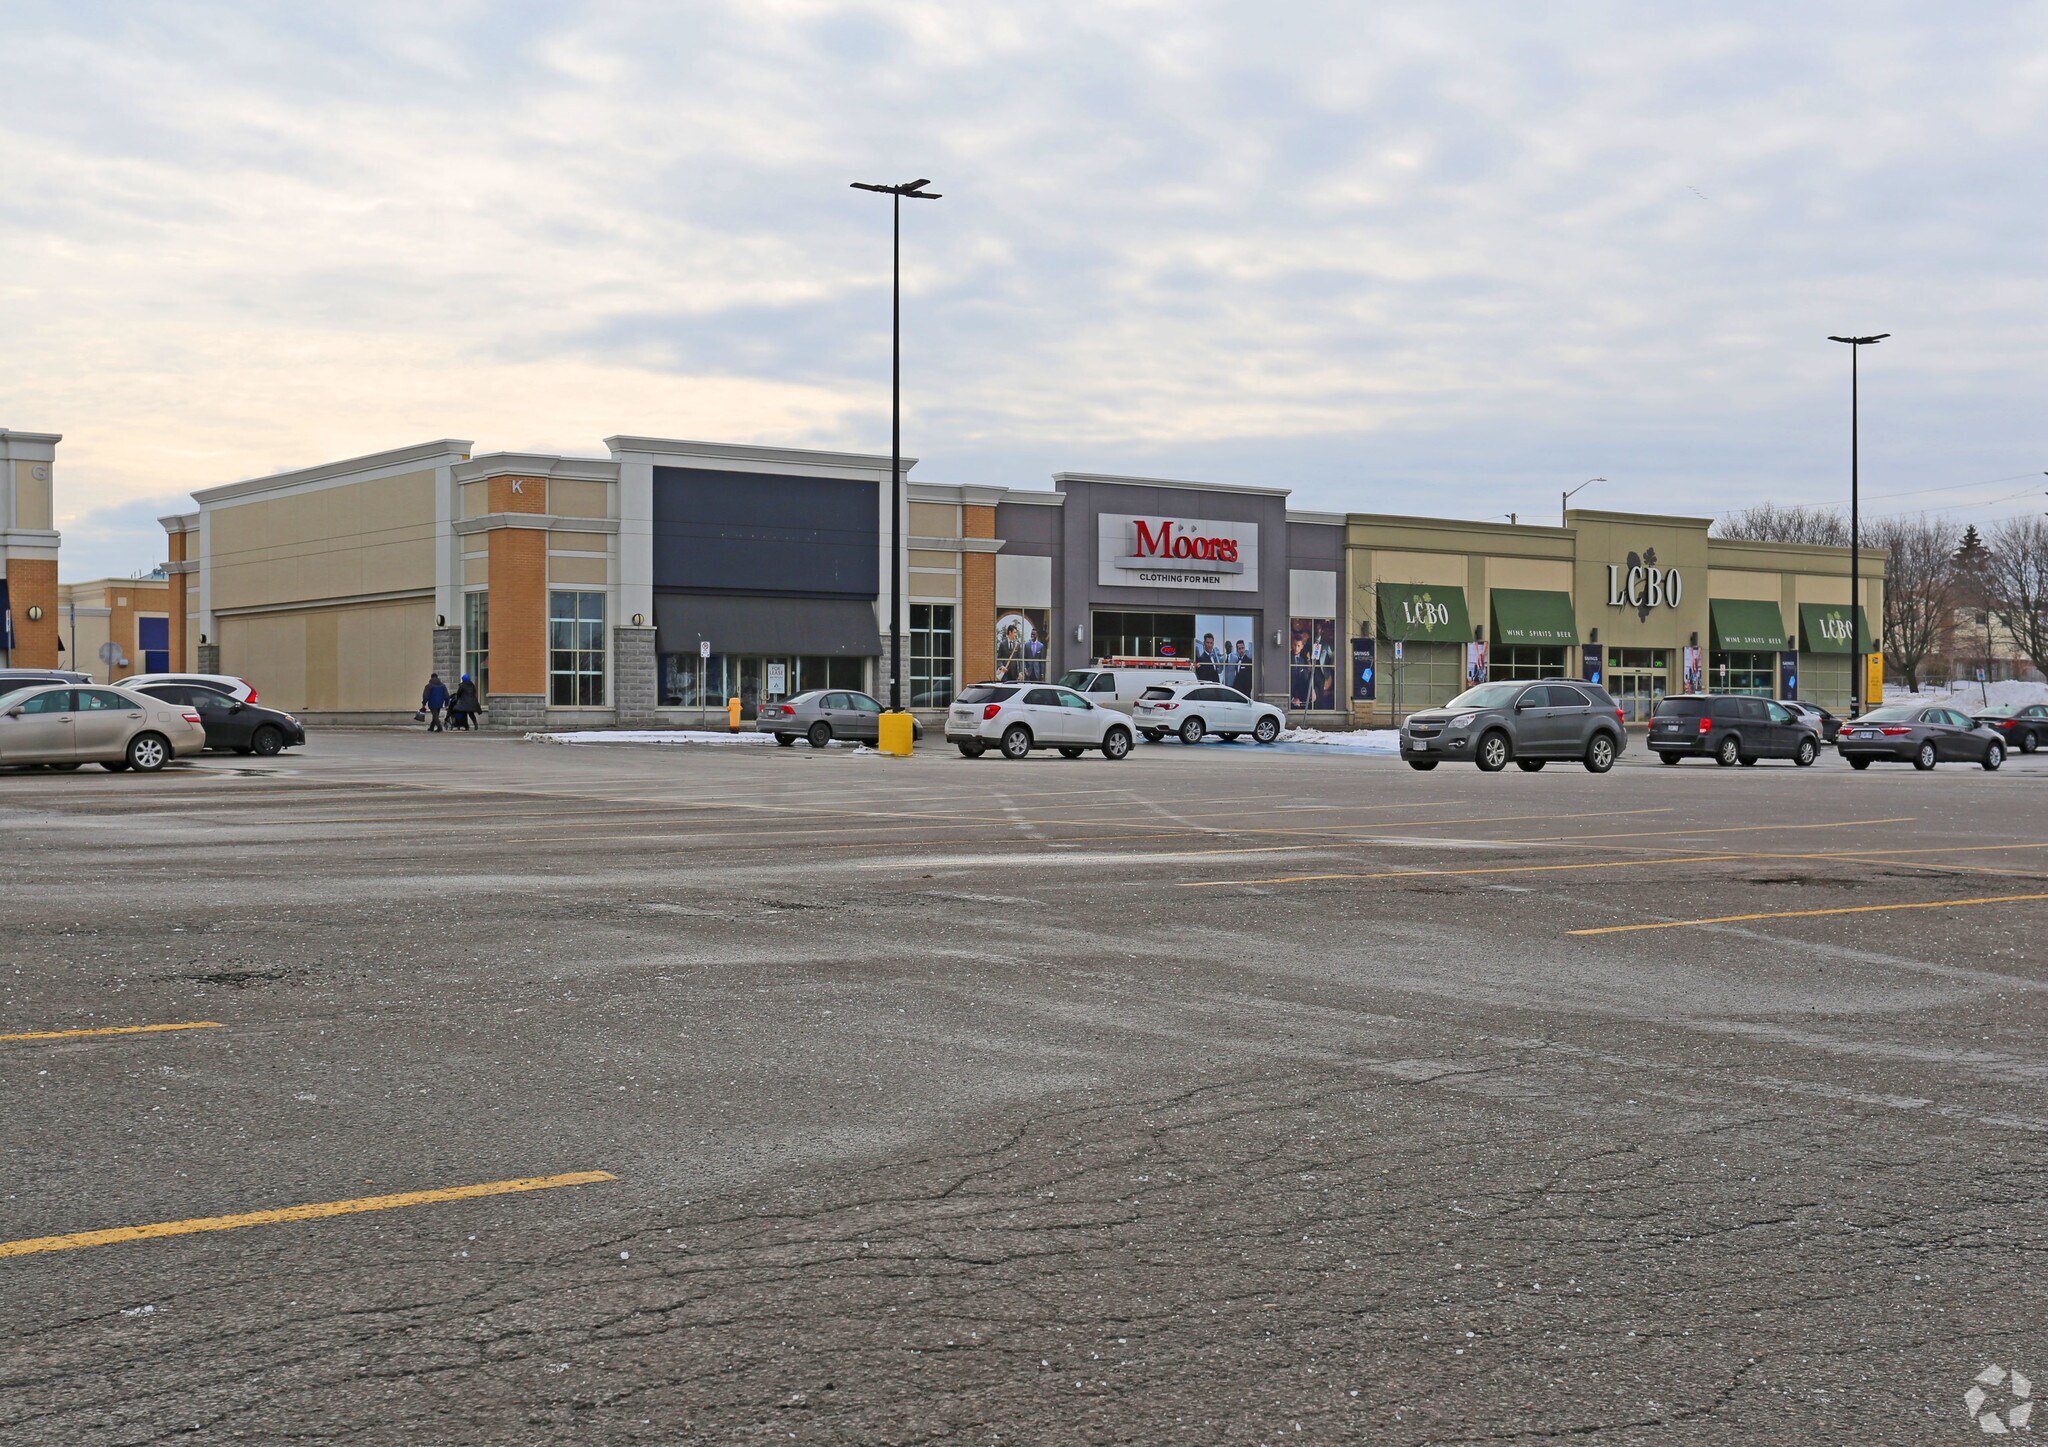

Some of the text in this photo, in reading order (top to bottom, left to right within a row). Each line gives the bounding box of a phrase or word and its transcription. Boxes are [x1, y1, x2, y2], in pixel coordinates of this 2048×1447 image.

[32, 464, 47, 480] G
[512, 480, 523, 494] K
[1133, 520, 1237, 562] Moores
[1139, 573, 1220, 584] CLOTHING FOR MEN
[1607, 564, 1683, 608] LCBO
[1402, 601, 1449, 626] LCBO
[1506, 629, 1524, 637] WINE
[1529, 630, 1552, 638] SPIRITS
[1819, 618, 1852, 640] LCBO
